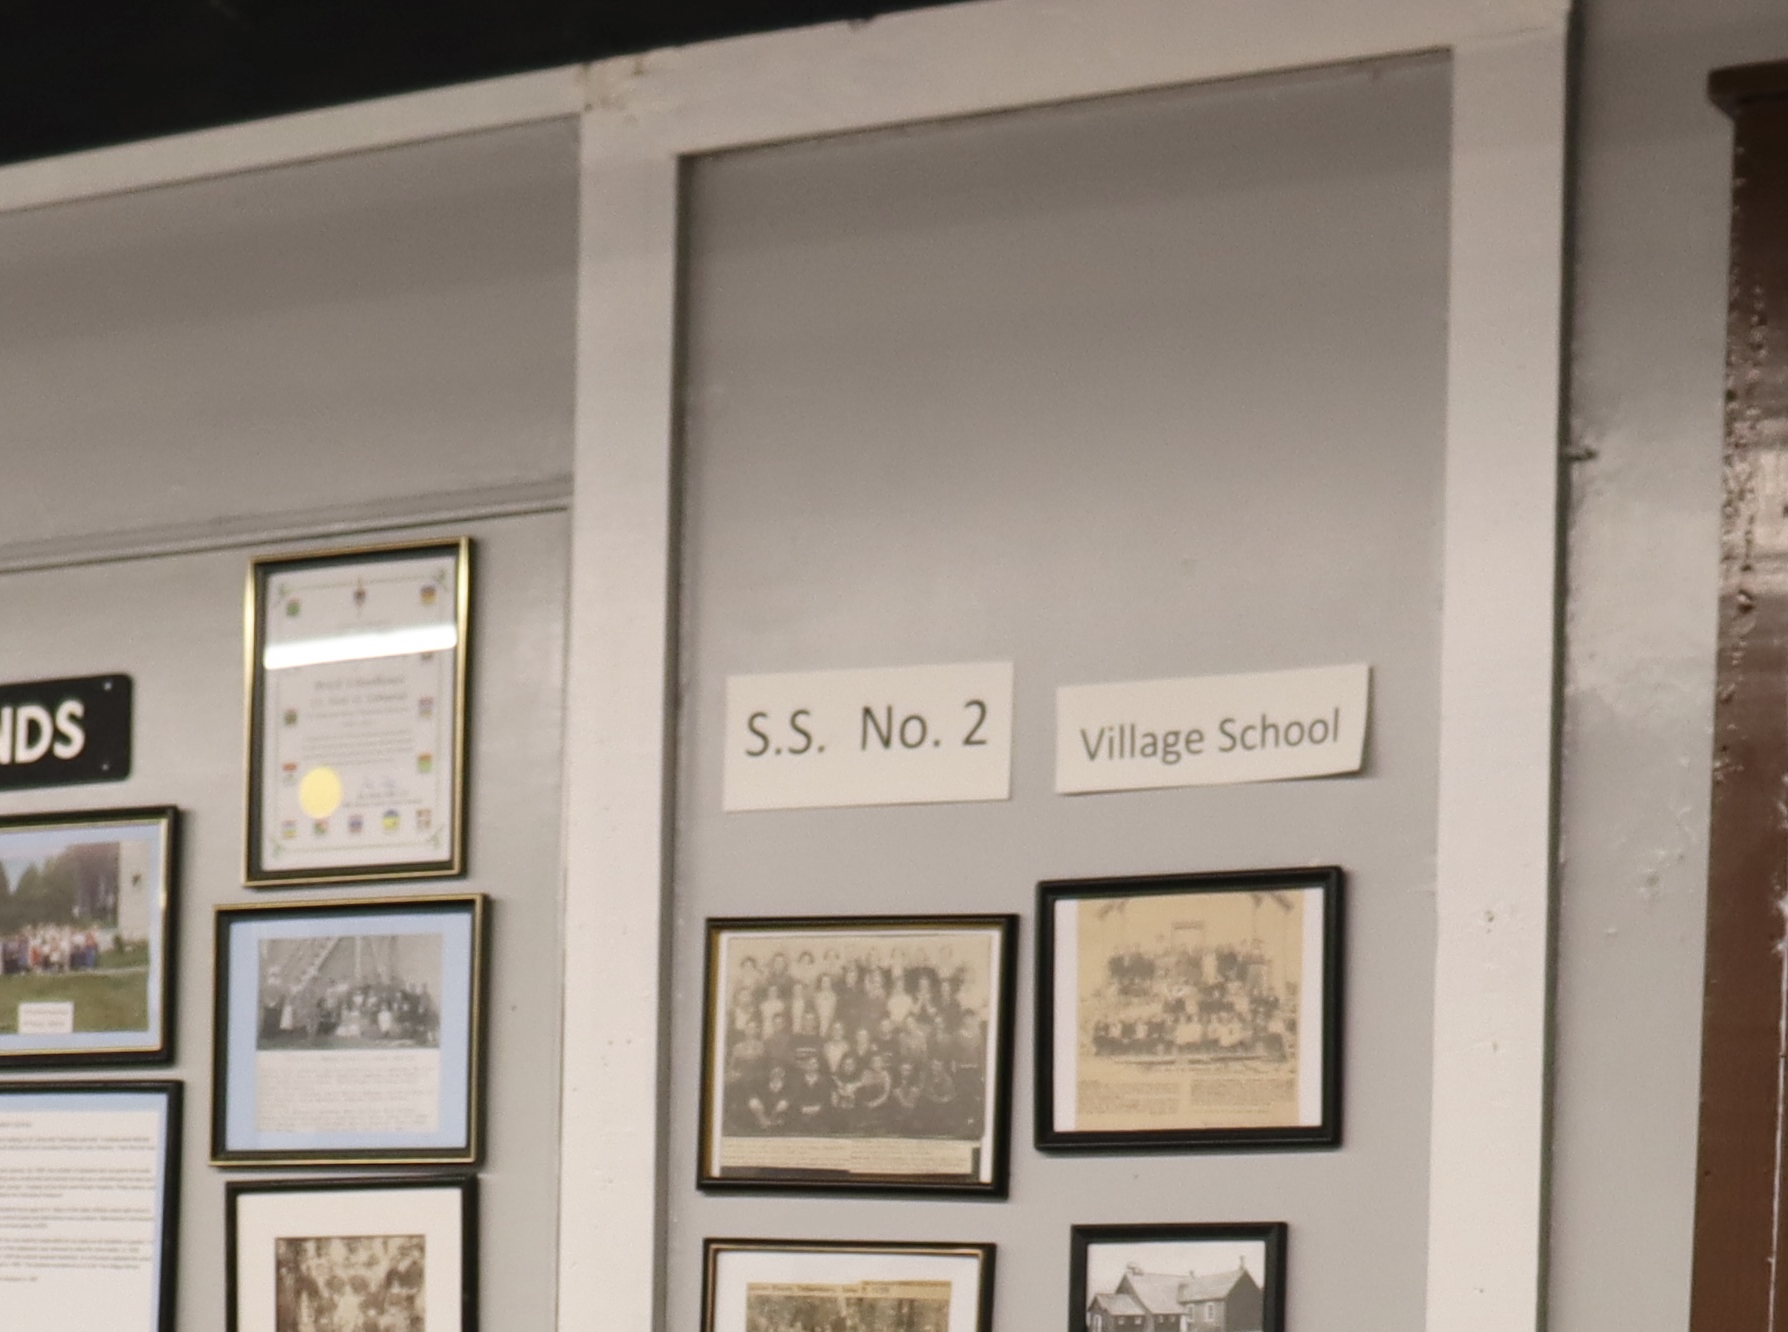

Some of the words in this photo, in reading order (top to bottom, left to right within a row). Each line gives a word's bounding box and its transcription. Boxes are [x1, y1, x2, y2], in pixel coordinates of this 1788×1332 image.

[745, 709, 827, 758] S.S.
[861, 704, 941, 750] No.
[963, 698, 989, 747] 2
[1080, 718, 1205, 766] Village
[1218, 708, 1341, 754] School
